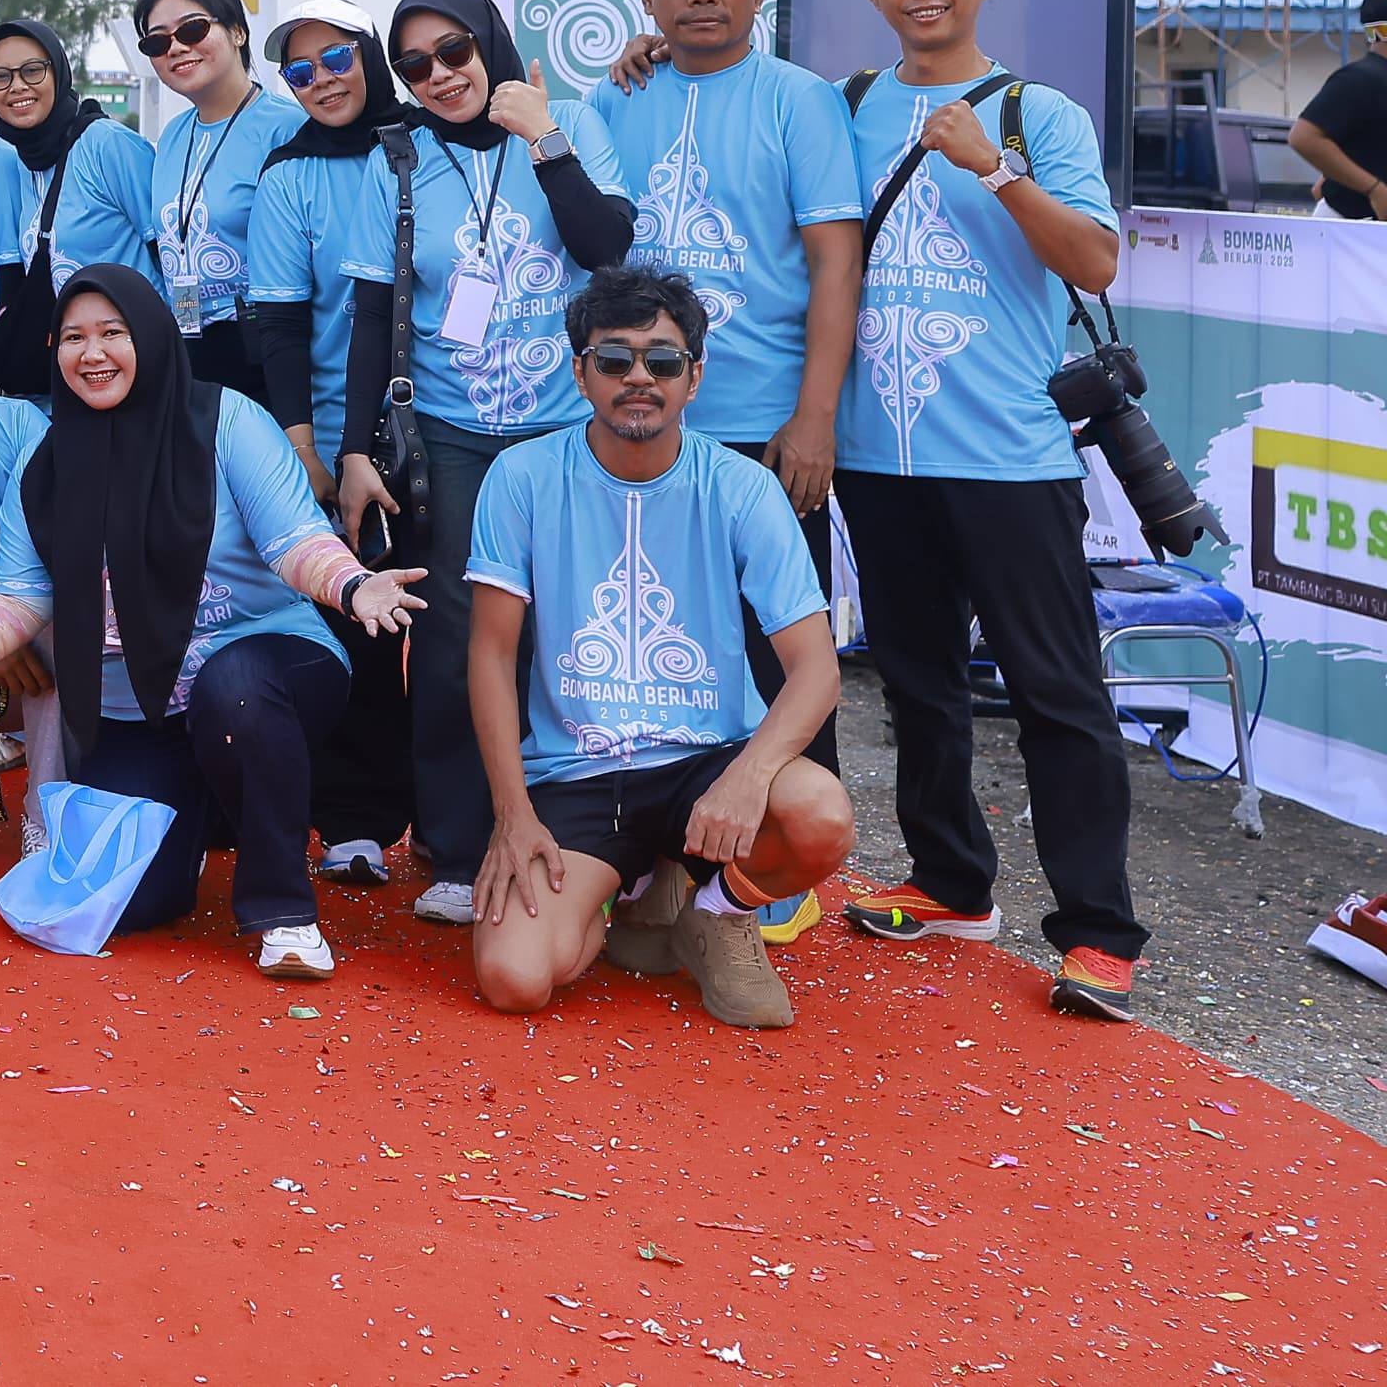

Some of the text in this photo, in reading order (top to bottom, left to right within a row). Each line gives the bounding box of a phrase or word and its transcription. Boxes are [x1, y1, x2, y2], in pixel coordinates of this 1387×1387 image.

[1223, 230, 1294, 252] BOMBANA
[627, 248, 745, 272] MBANA BERLARI
[1224, 252, 1263, 265] BERLARI
[1270, 255, 1294, 267] 2025
[199, 282, 249, 299] BERLA
[912, 269, 987, 299] BERLARI
[1287, 491, 1387, 561] TBS
[194, 603, 233, 627] LARI
[560, 676, 719, 710] BOMBANA BERLARI
[600, 706, 668, 721] 2025
